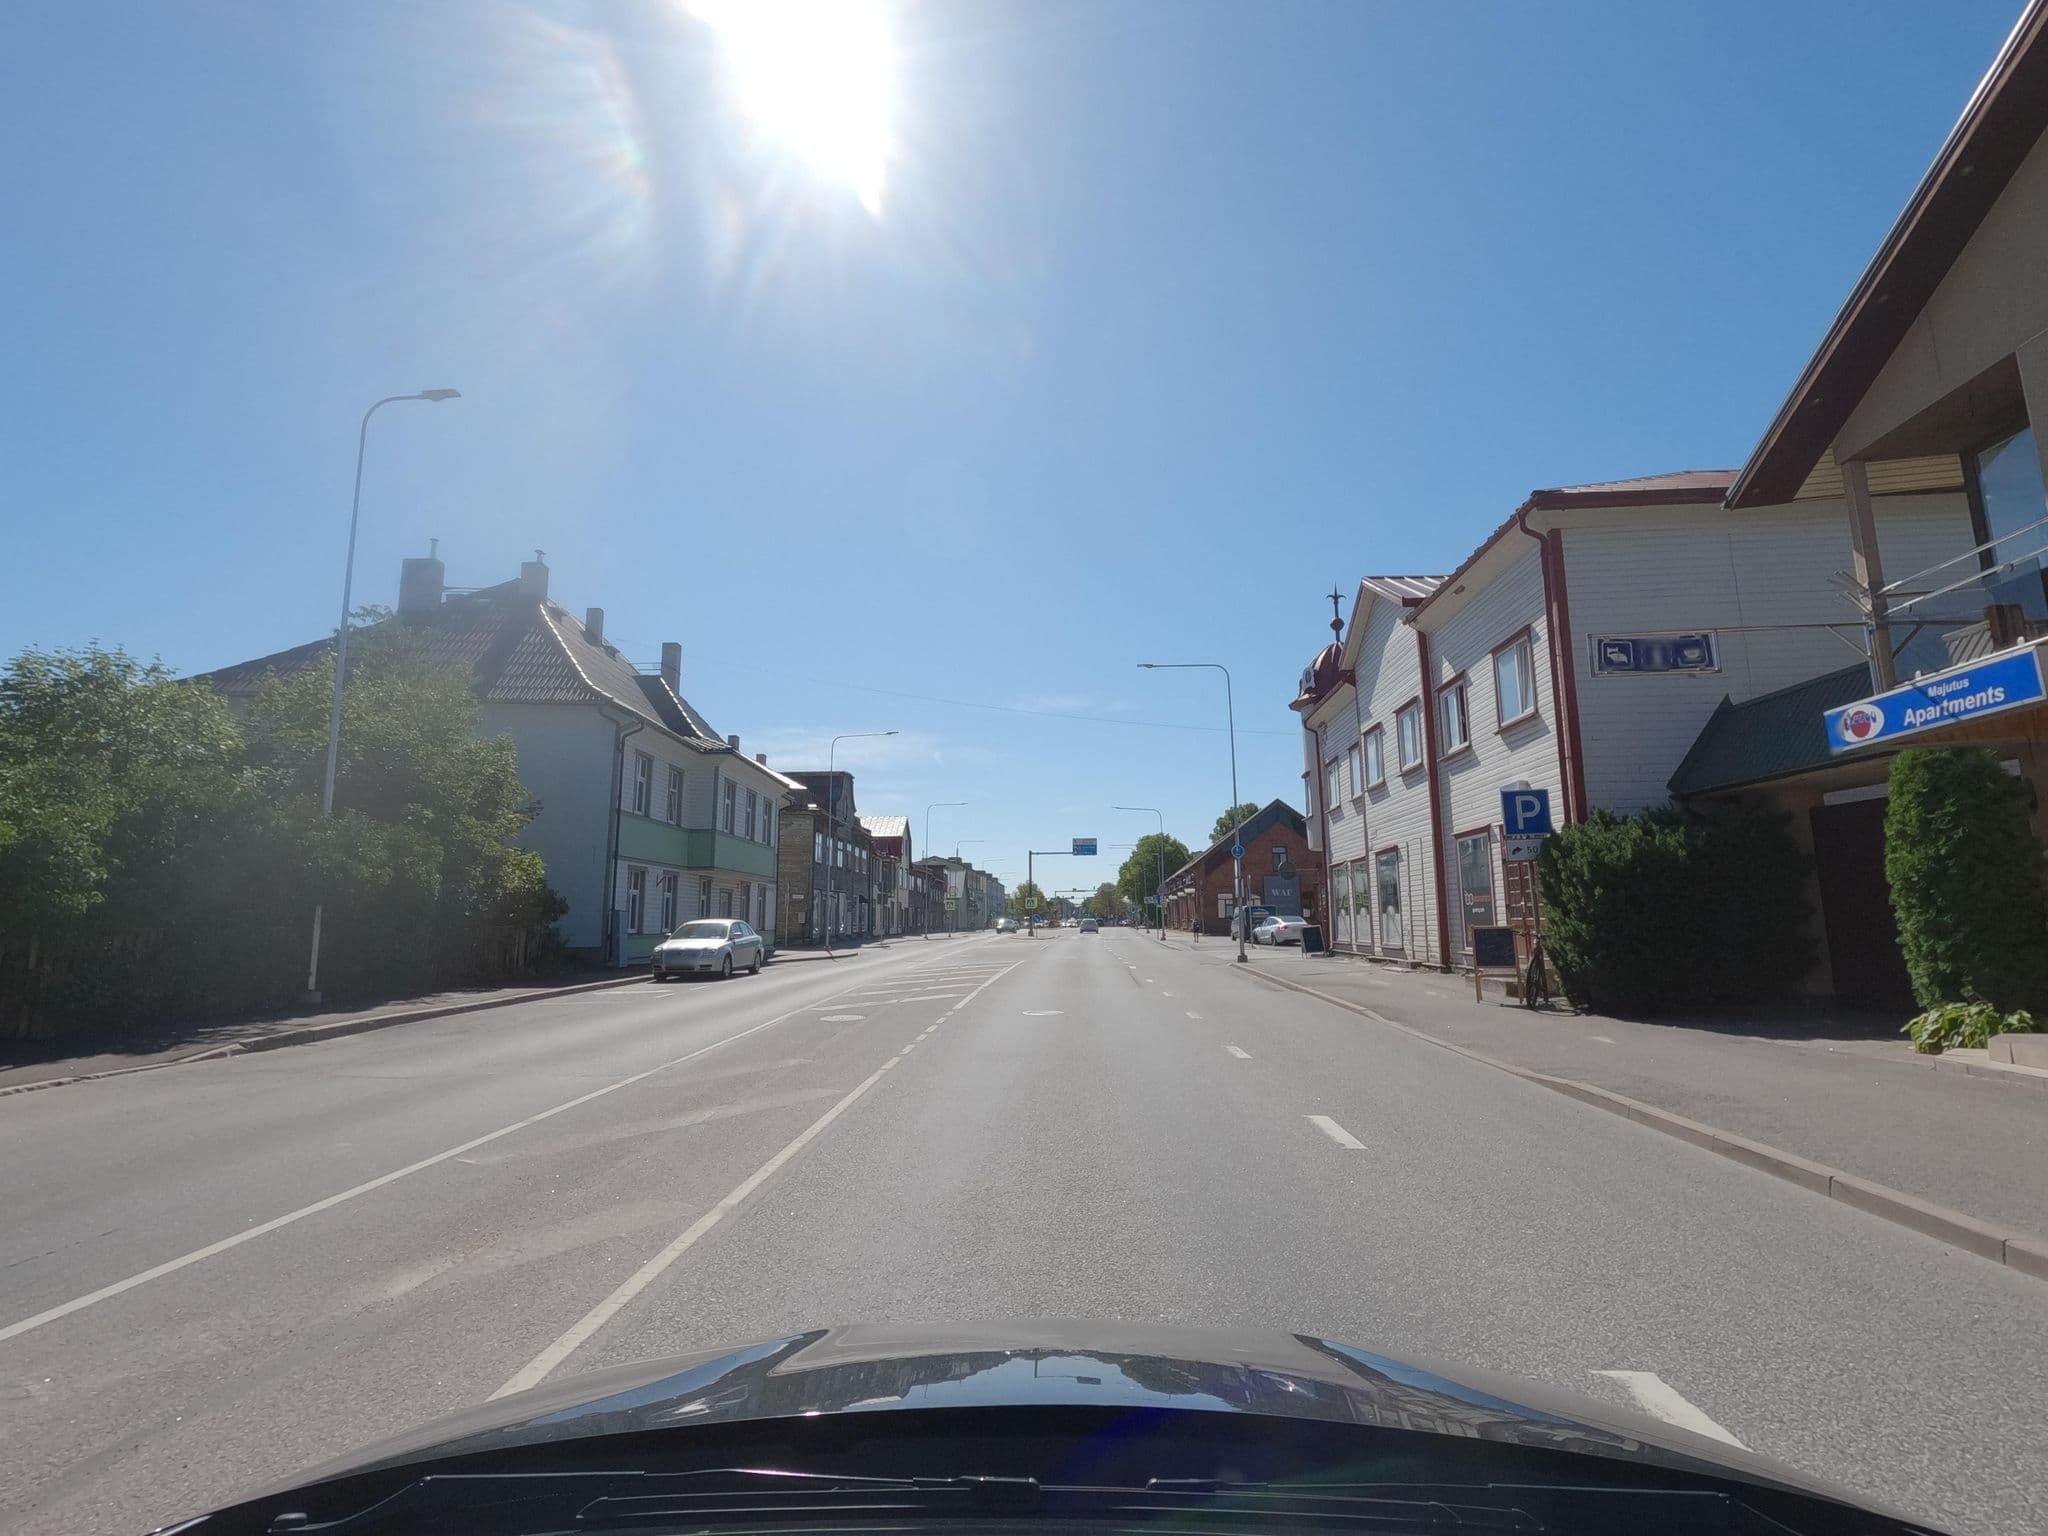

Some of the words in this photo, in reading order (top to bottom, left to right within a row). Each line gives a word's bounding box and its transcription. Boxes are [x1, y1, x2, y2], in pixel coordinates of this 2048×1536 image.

[1928, 678, 1970, 697] Majutus
[1903, 686, 2006, 727] Apartments
[1515, 795, 1541, 830] P
